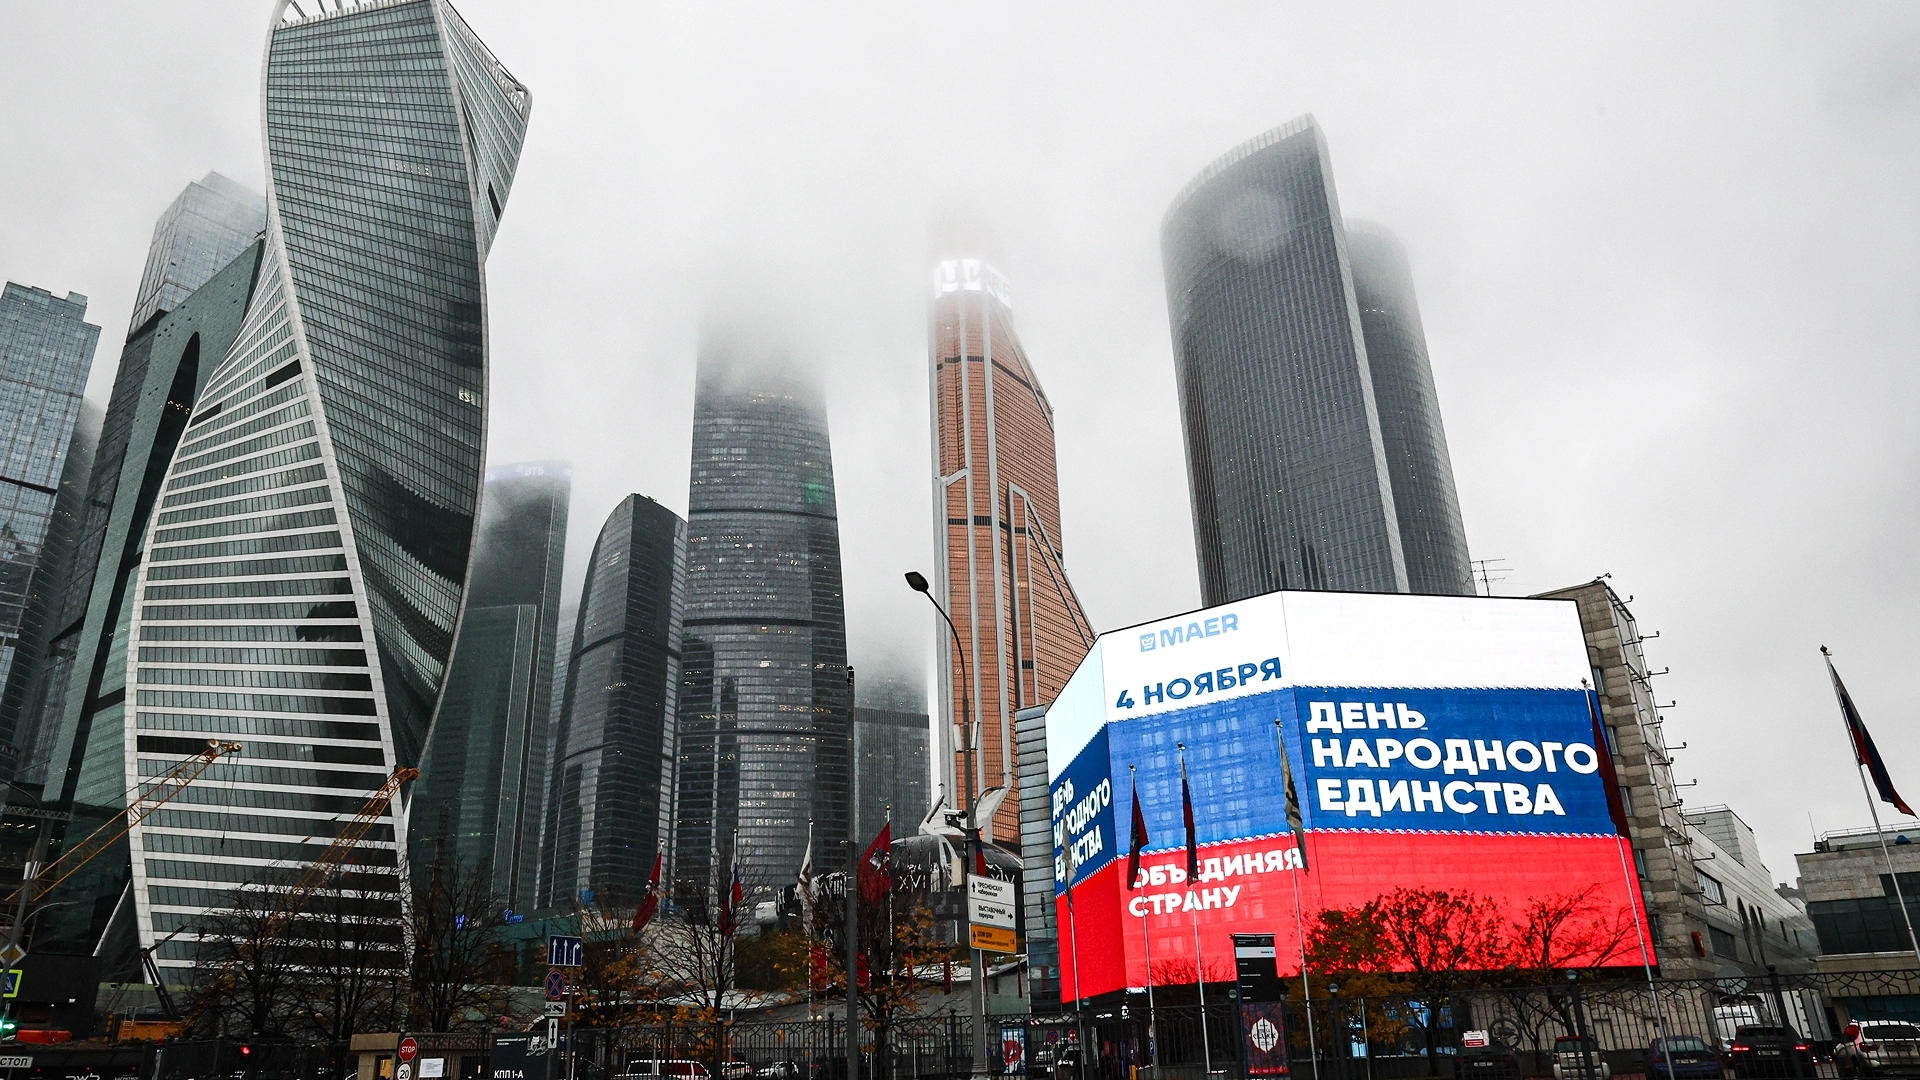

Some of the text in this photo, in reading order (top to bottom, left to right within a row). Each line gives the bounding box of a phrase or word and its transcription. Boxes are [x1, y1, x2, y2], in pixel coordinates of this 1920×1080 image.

[1159, 613, 1240, 648] MAER
[1116, 656, 1282, 709] 4 НОЯБРЯ
[1306, 702, 1426, 731] ДЕНЬ
[1312, 738, 1599, 776] НАРОДНОГО
[1317, 779, 1567, 817] ЕДИНСТВА
[1055, 824, 1104, 883] ЕДНСТВА
[1128, 884, 1242, 918] СТРАНУ
[0, 1057, 28, 1067] СТОП
[401, 1046, 416, 1054] STOP
[399, 1069, 410, 1079] 20
[494, 1069, 524, 1079] КПП 1-А
